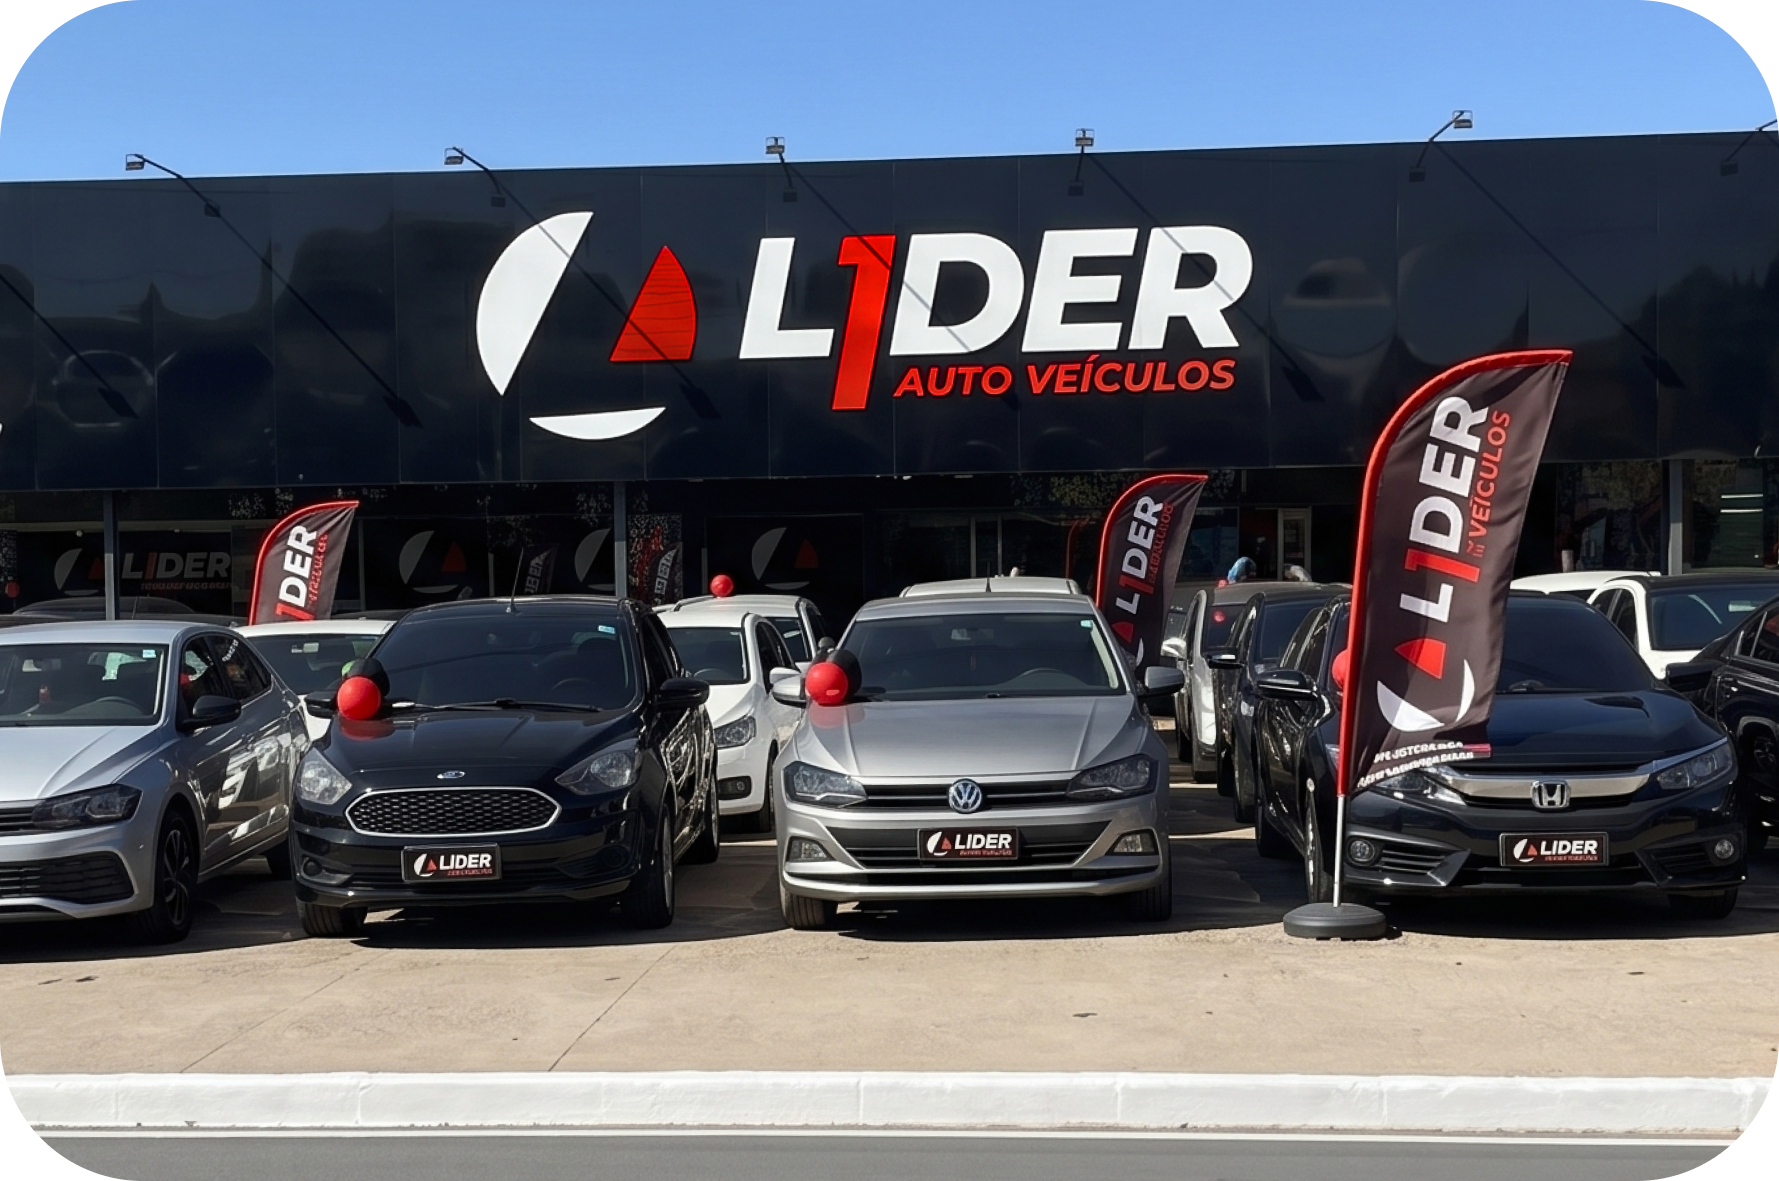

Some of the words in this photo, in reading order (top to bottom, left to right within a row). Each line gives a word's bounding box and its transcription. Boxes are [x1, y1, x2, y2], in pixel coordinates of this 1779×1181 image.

[893, 366, 1012, 397] AUTO
[1027, 354, 1236, 393] VEÍCULOS
[955, 834, 1012, 850] LIDER
[1540, 840, 1598, 855] LIDER
[440, 853, 492, 870] LIDER
